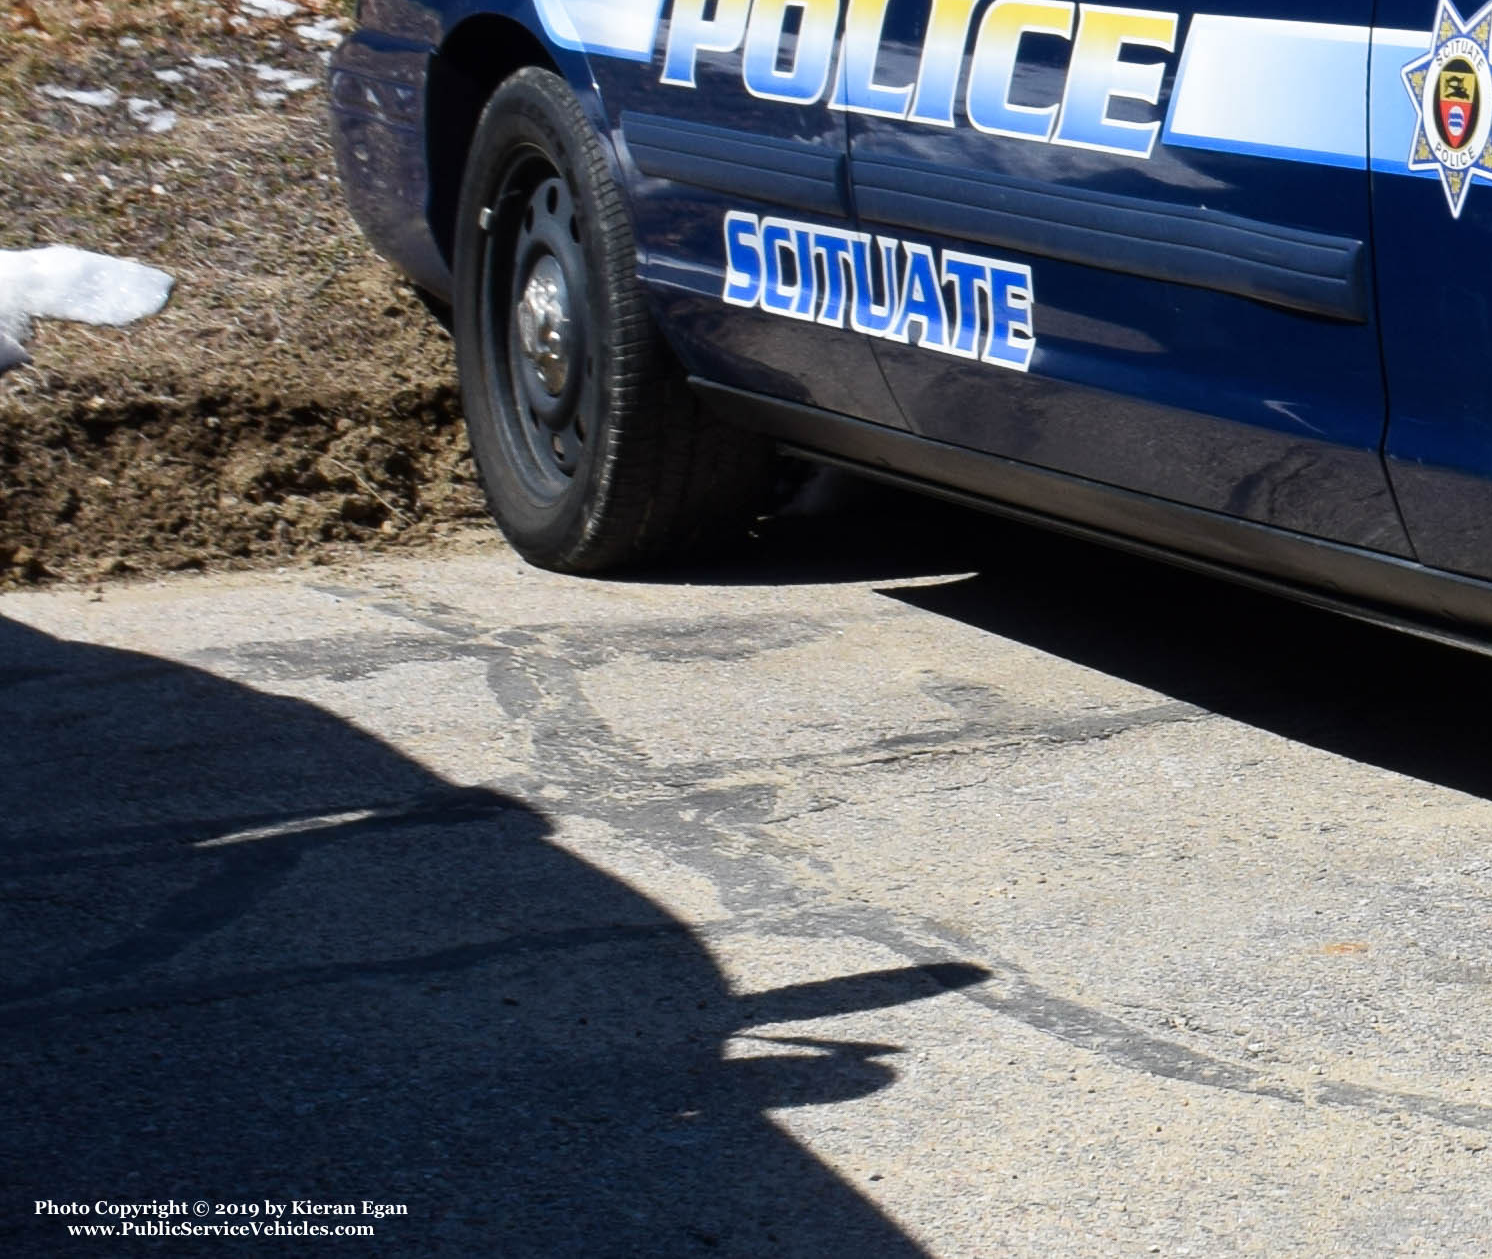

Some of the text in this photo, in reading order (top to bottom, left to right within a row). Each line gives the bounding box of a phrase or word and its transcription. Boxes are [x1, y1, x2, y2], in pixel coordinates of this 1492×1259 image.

[1435, 39, 1486, 72] SCITUATE
[1434, 143, 1476, 168] POLICE
[722, 209, 1037, 373] SCITUATE
